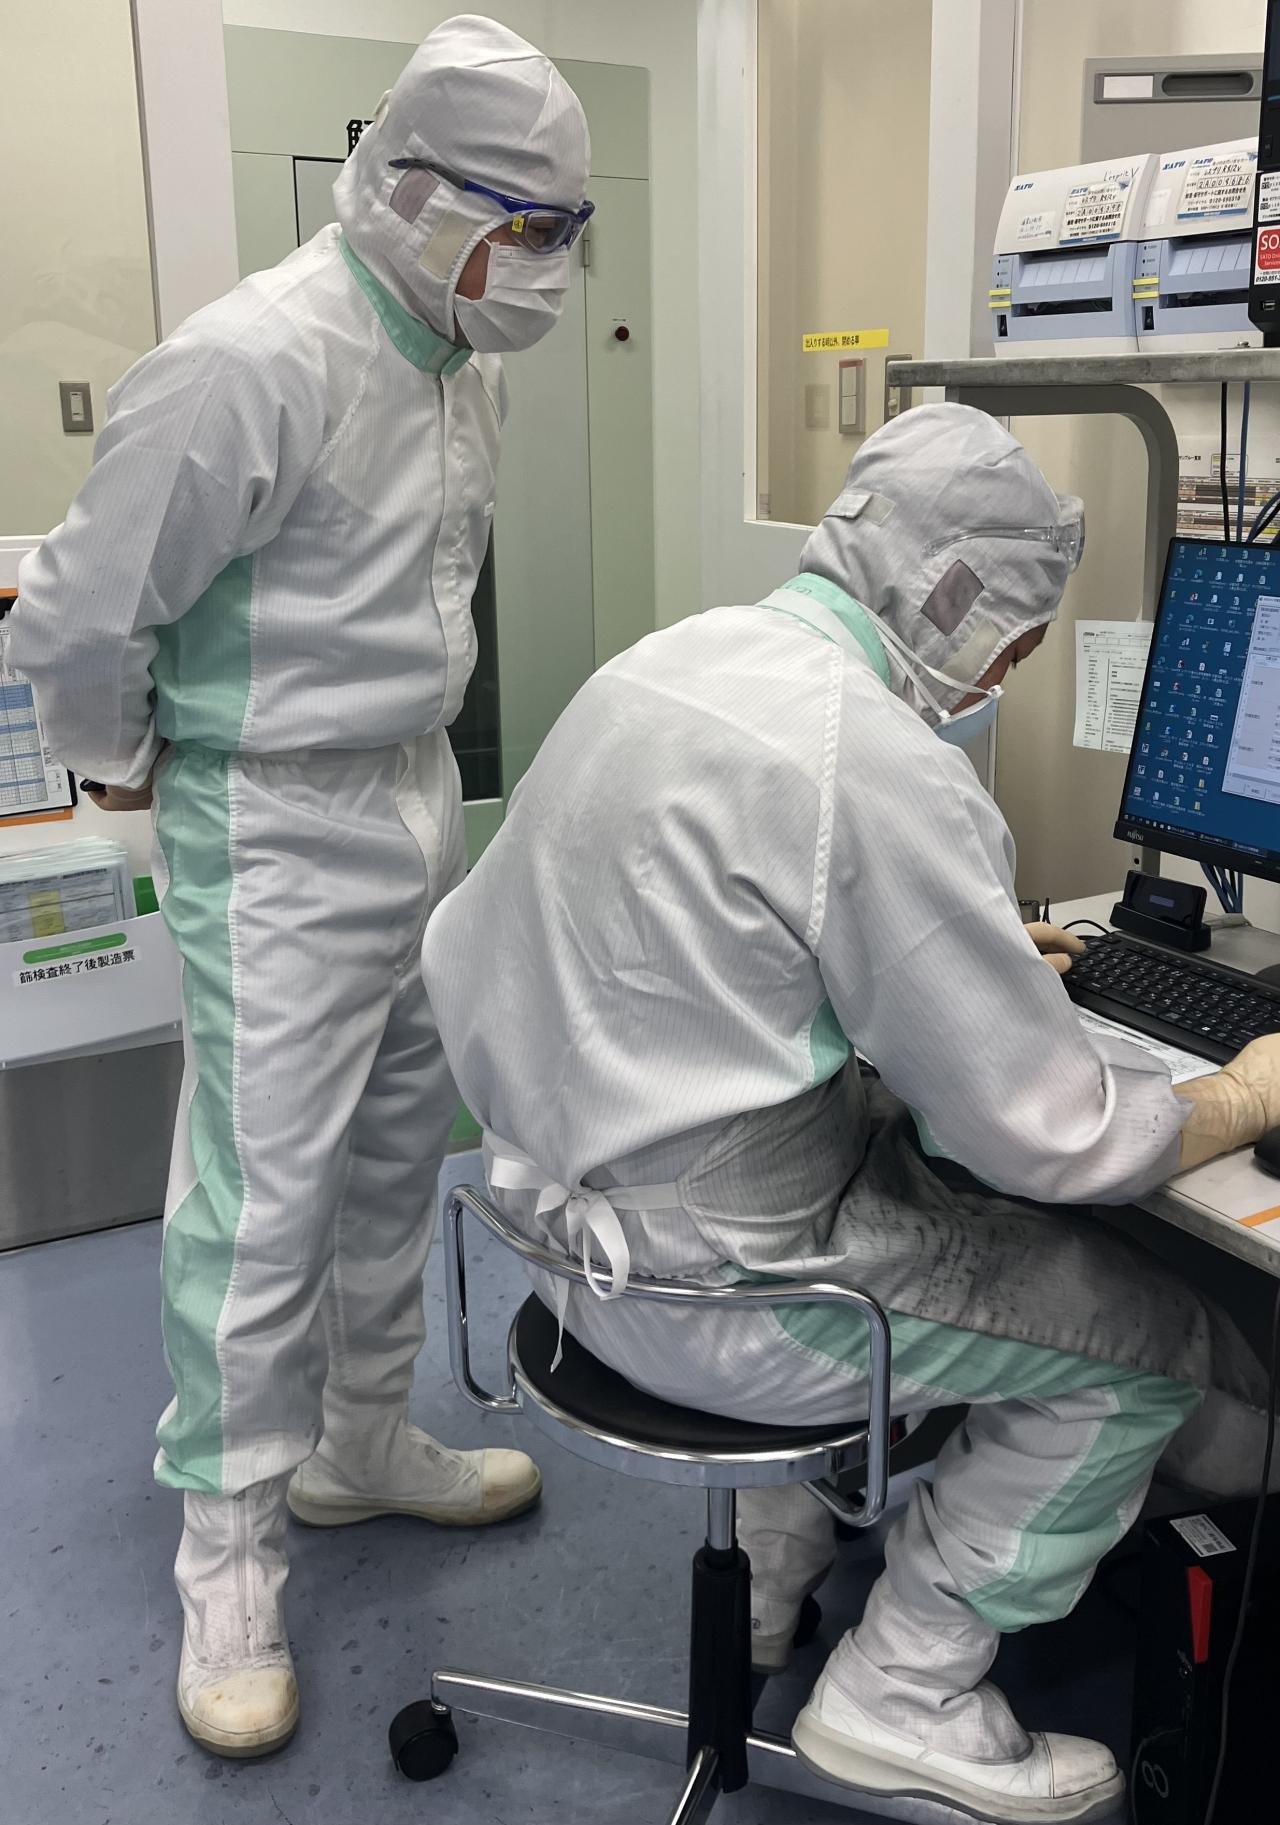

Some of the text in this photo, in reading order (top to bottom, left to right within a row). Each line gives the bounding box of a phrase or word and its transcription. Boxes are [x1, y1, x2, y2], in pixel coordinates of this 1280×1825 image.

[1162, 161, 1186, 170] SATO
[1014, 183, 1034, 191] SATO
[1260, 234, 1280, 251] SO
[20, 949, 135, 984] 篩検査終了後製造票
